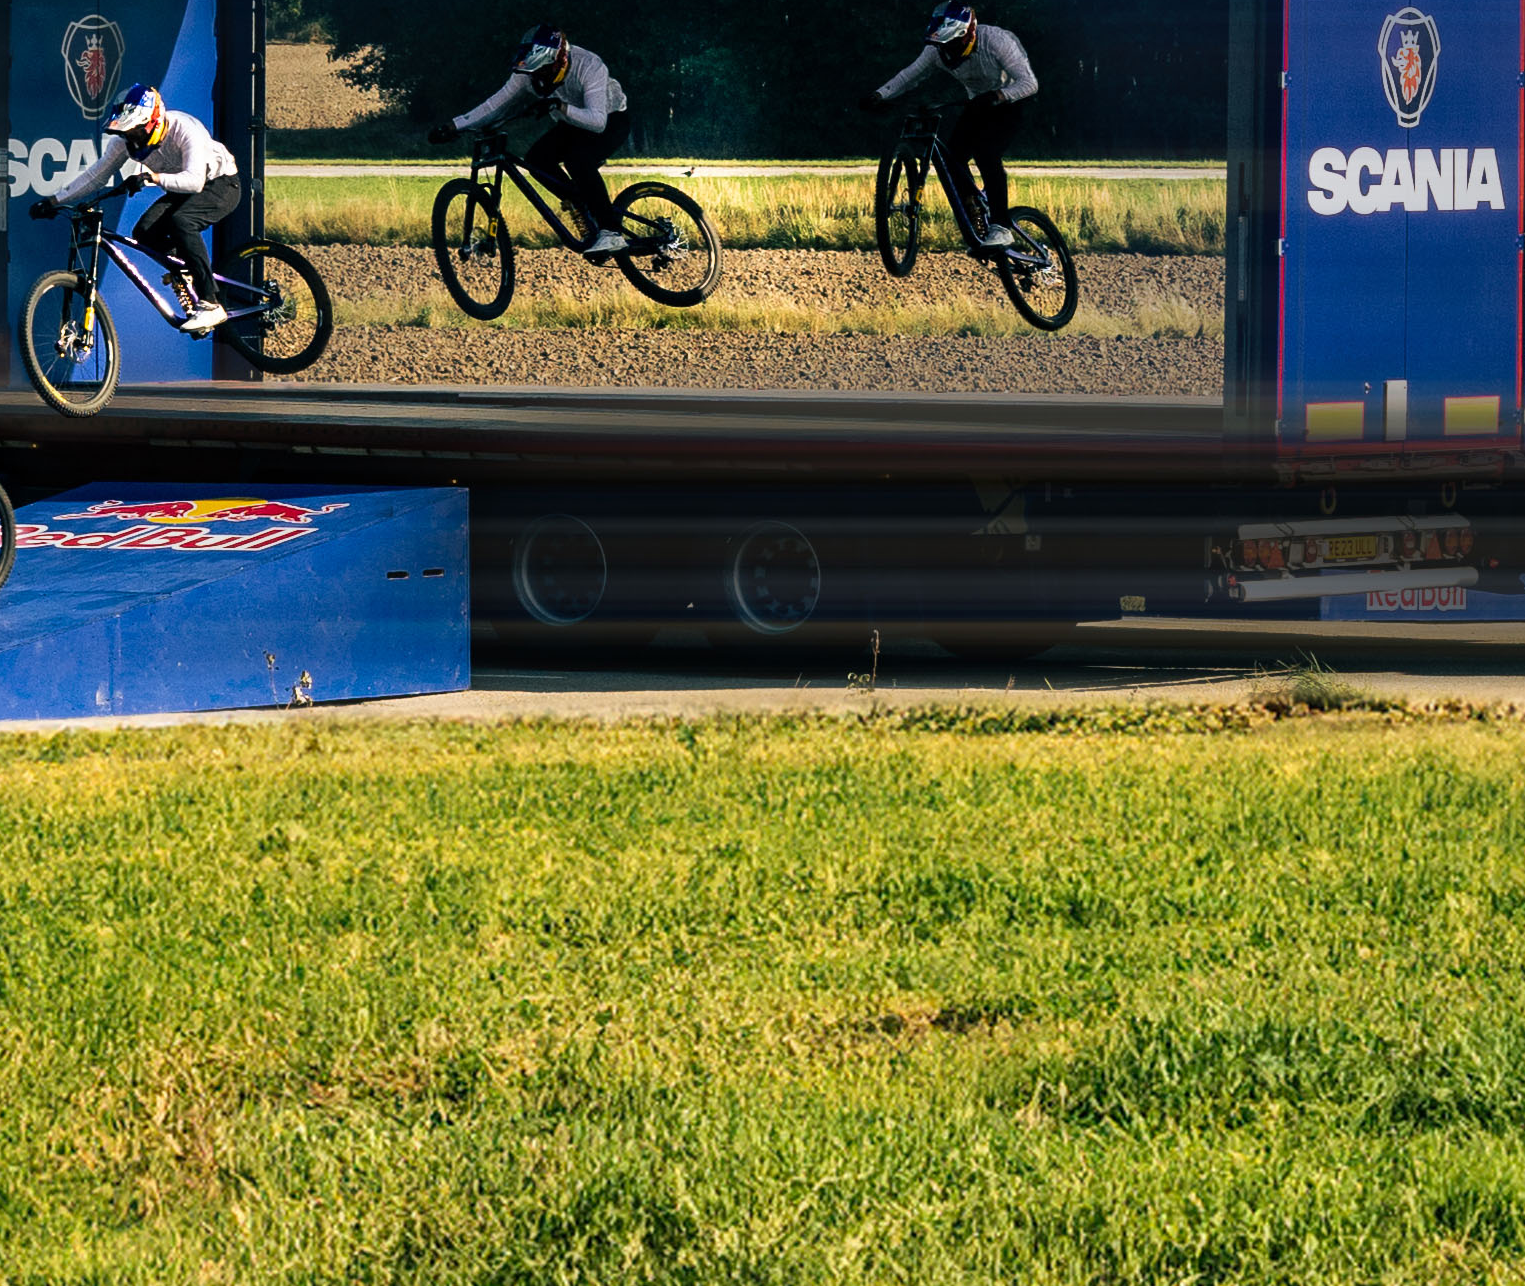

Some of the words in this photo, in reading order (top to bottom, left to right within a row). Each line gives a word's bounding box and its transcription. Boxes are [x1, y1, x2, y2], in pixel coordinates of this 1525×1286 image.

[1307, 146, 1506, 216] SCANIA
[107, 525, 319, 552] Bull
[1327, 539, 1353, 557] RE23
[1355, 537, 1373, 555] ULL
